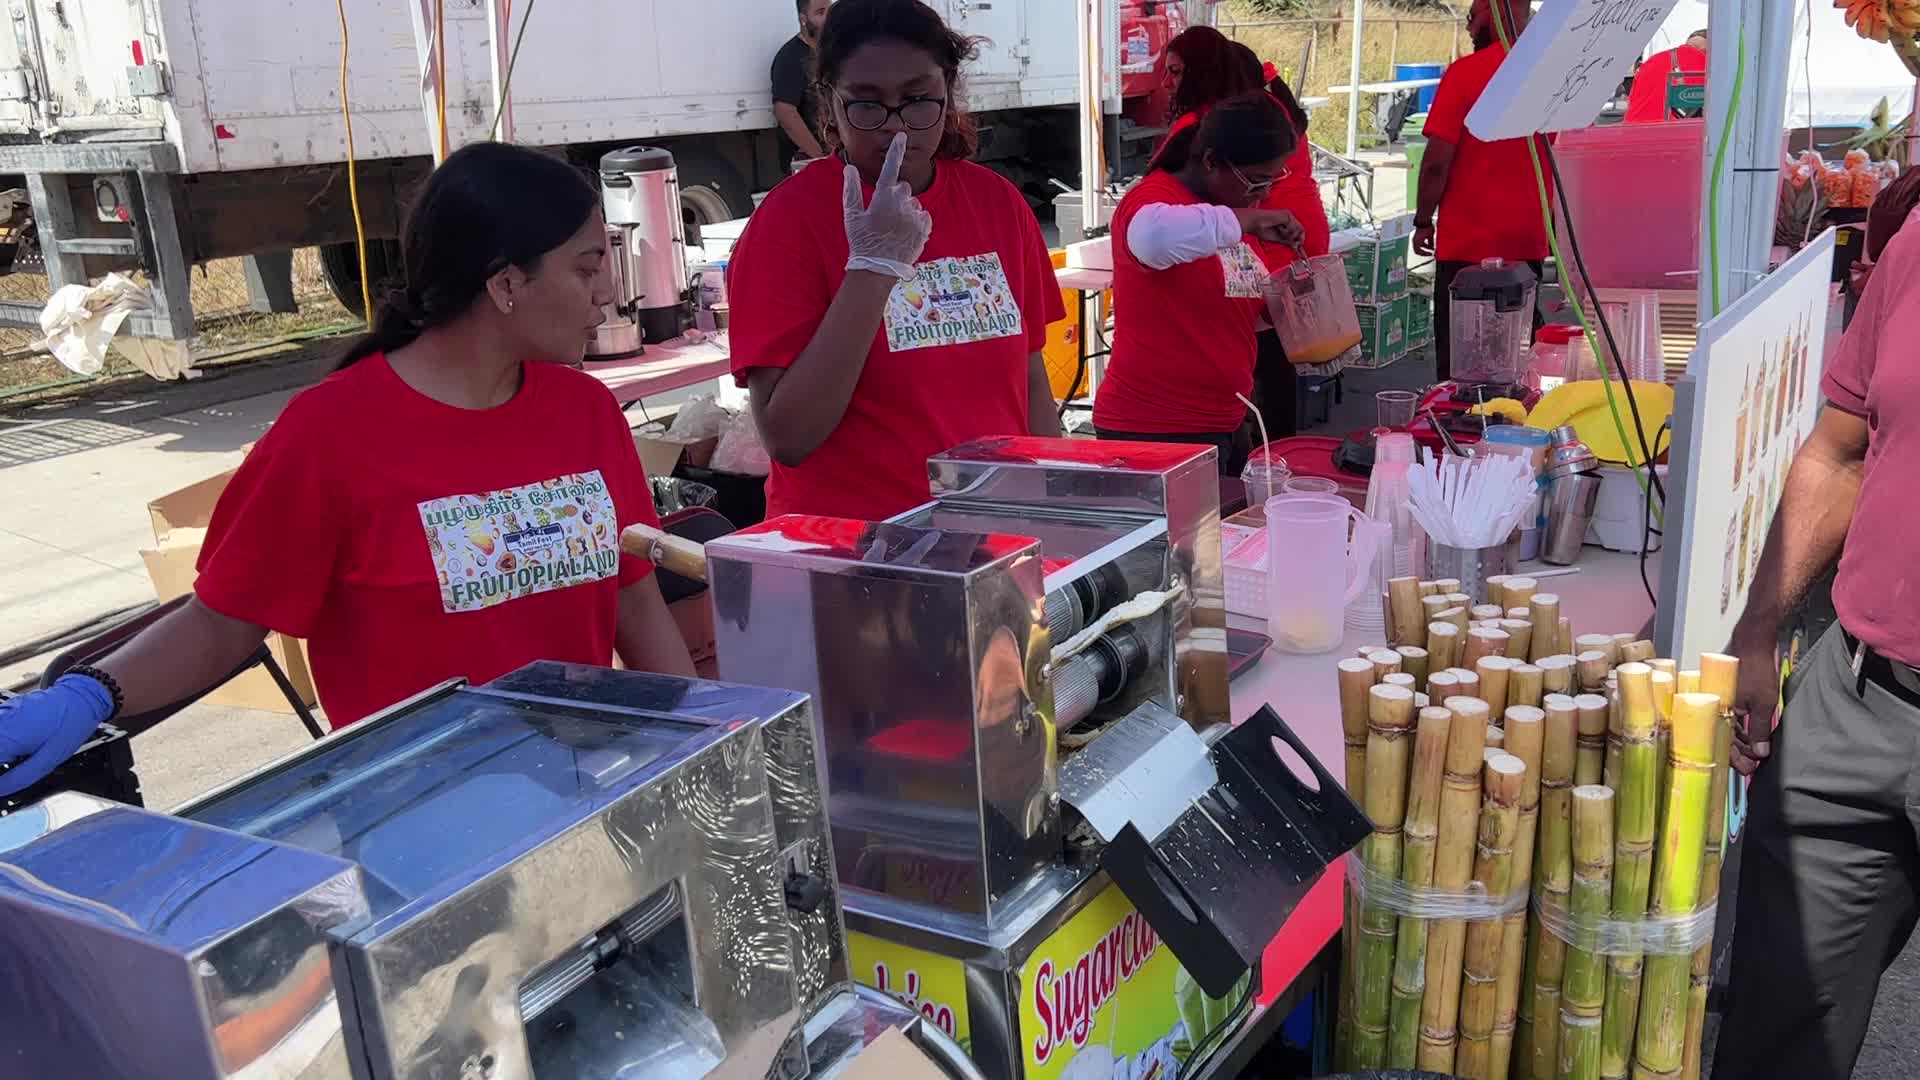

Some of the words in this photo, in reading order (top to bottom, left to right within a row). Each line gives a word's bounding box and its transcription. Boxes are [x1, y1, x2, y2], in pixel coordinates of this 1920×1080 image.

[894, 312, 1017, 343] FRUITOPIALAND
[528, 482, 602, 505] சோலை
[451, 549, 616, 604] FRUITOPIALAND
